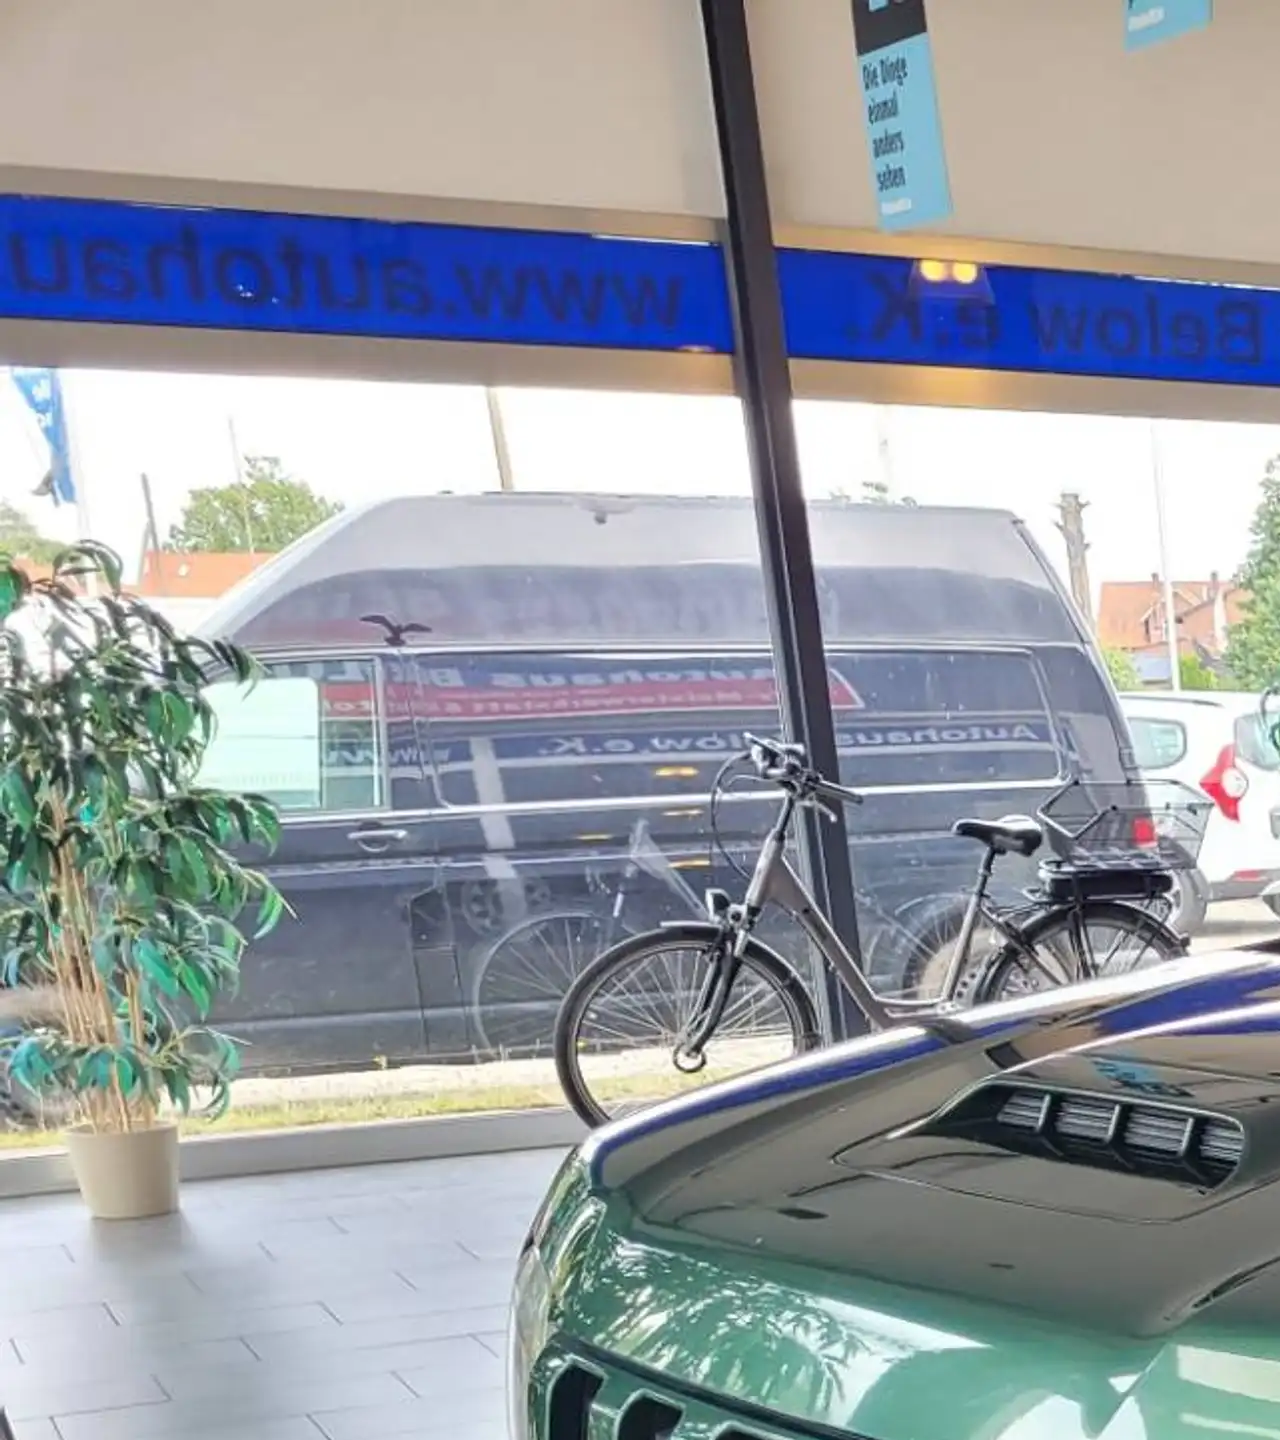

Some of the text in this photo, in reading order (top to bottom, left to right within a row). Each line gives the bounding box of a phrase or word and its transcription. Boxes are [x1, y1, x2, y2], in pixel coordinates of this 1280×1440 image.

[862, 56, 908, 91] Die Dinge
[867, 90, 899, 125] einmal
[872, 128, 905, 159] anders
[876, 164, 907, 192] sehen
